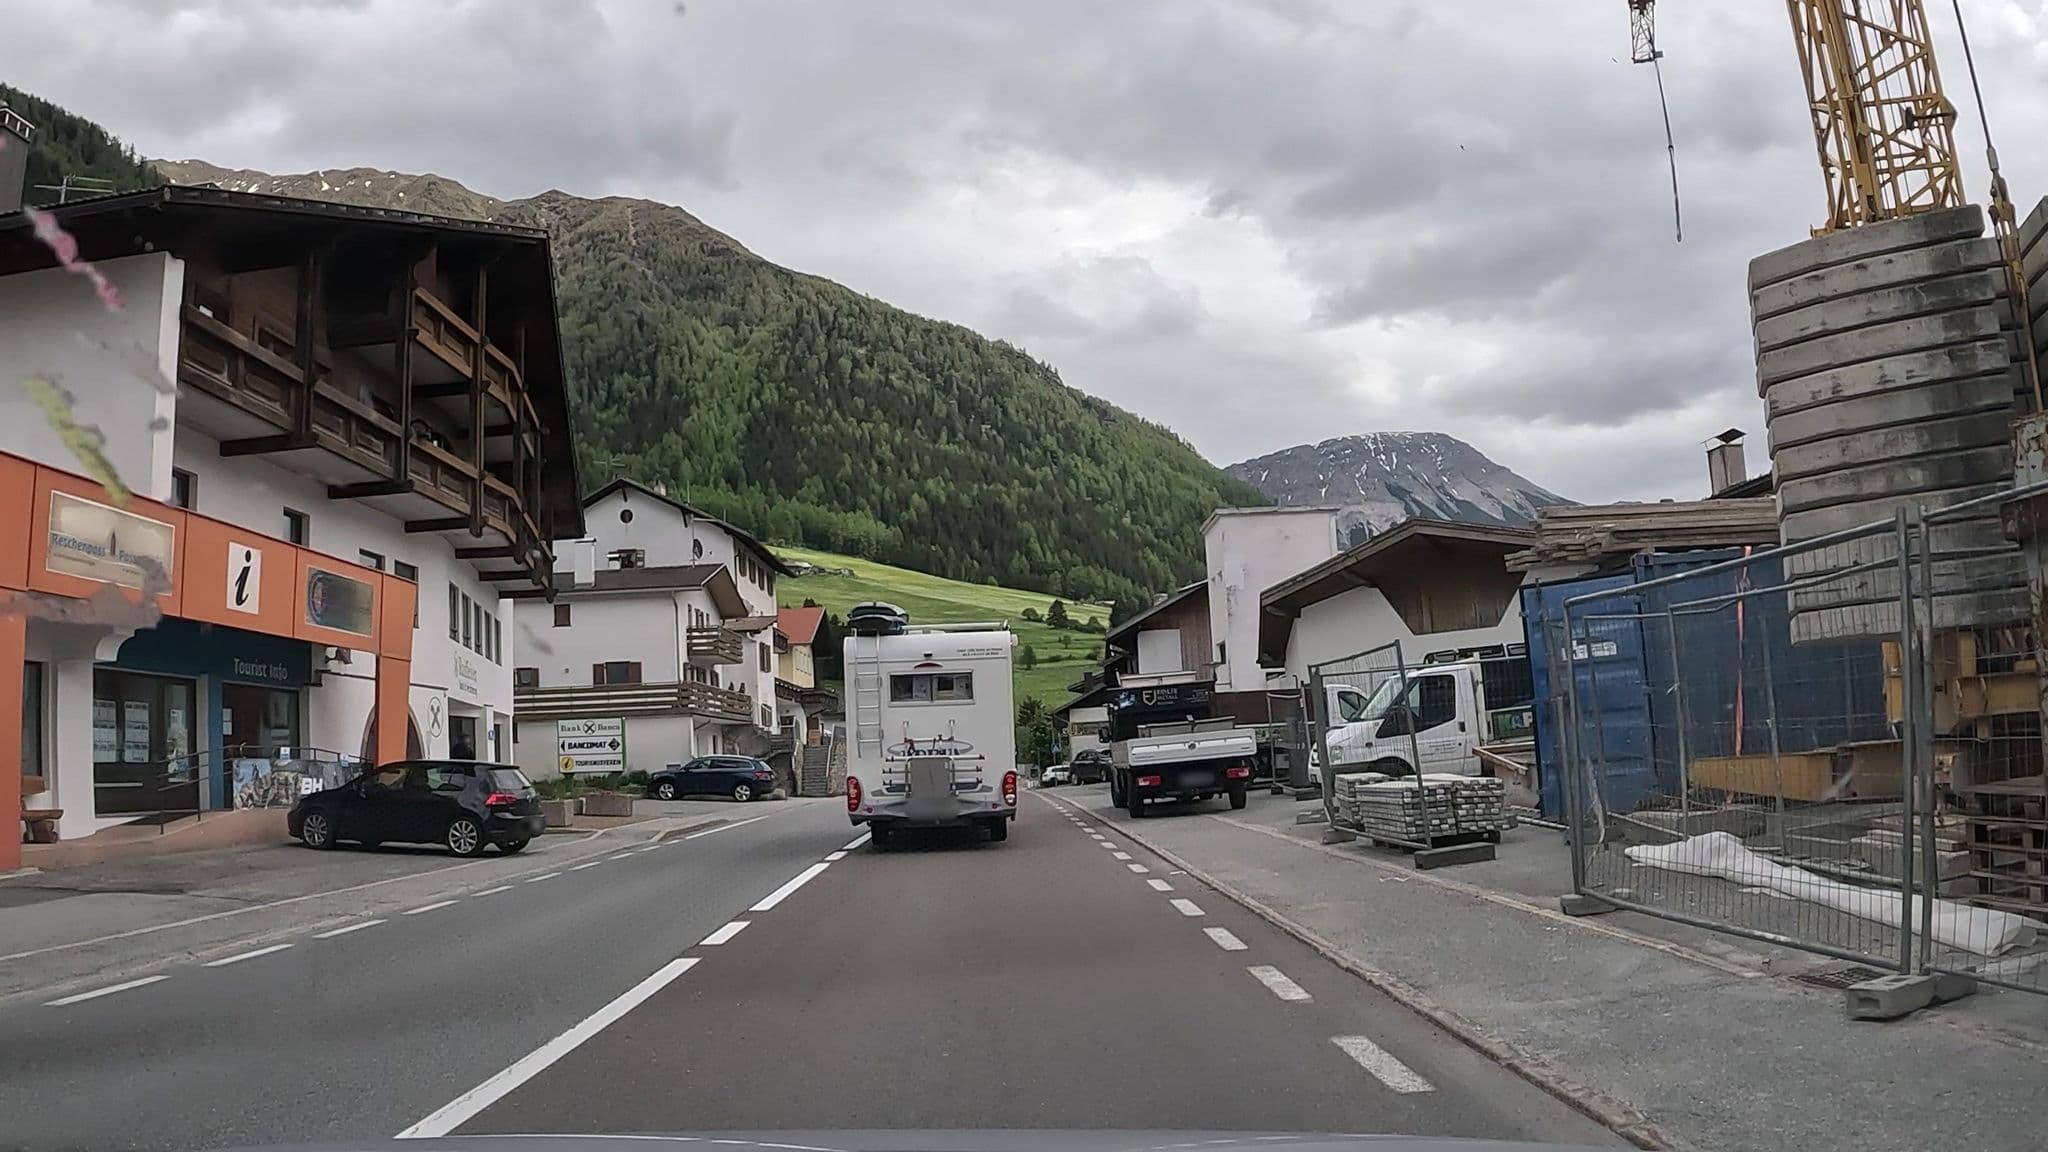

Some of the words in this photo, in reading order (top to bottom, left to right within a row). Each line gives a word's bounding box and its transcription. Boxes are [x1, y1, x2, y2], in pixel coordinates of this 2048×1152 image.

[51, 533, 106, 557] Reschenpass
[233, 657, 267, 678] Tourist
[269, 661, 288, 681] Info
[560, 724, 581, 732] Bank
[597, 723, 620, 731] Banca
[567, 741, 607, 750] BANCOMAT
[301, 777, 323, 795] BH
